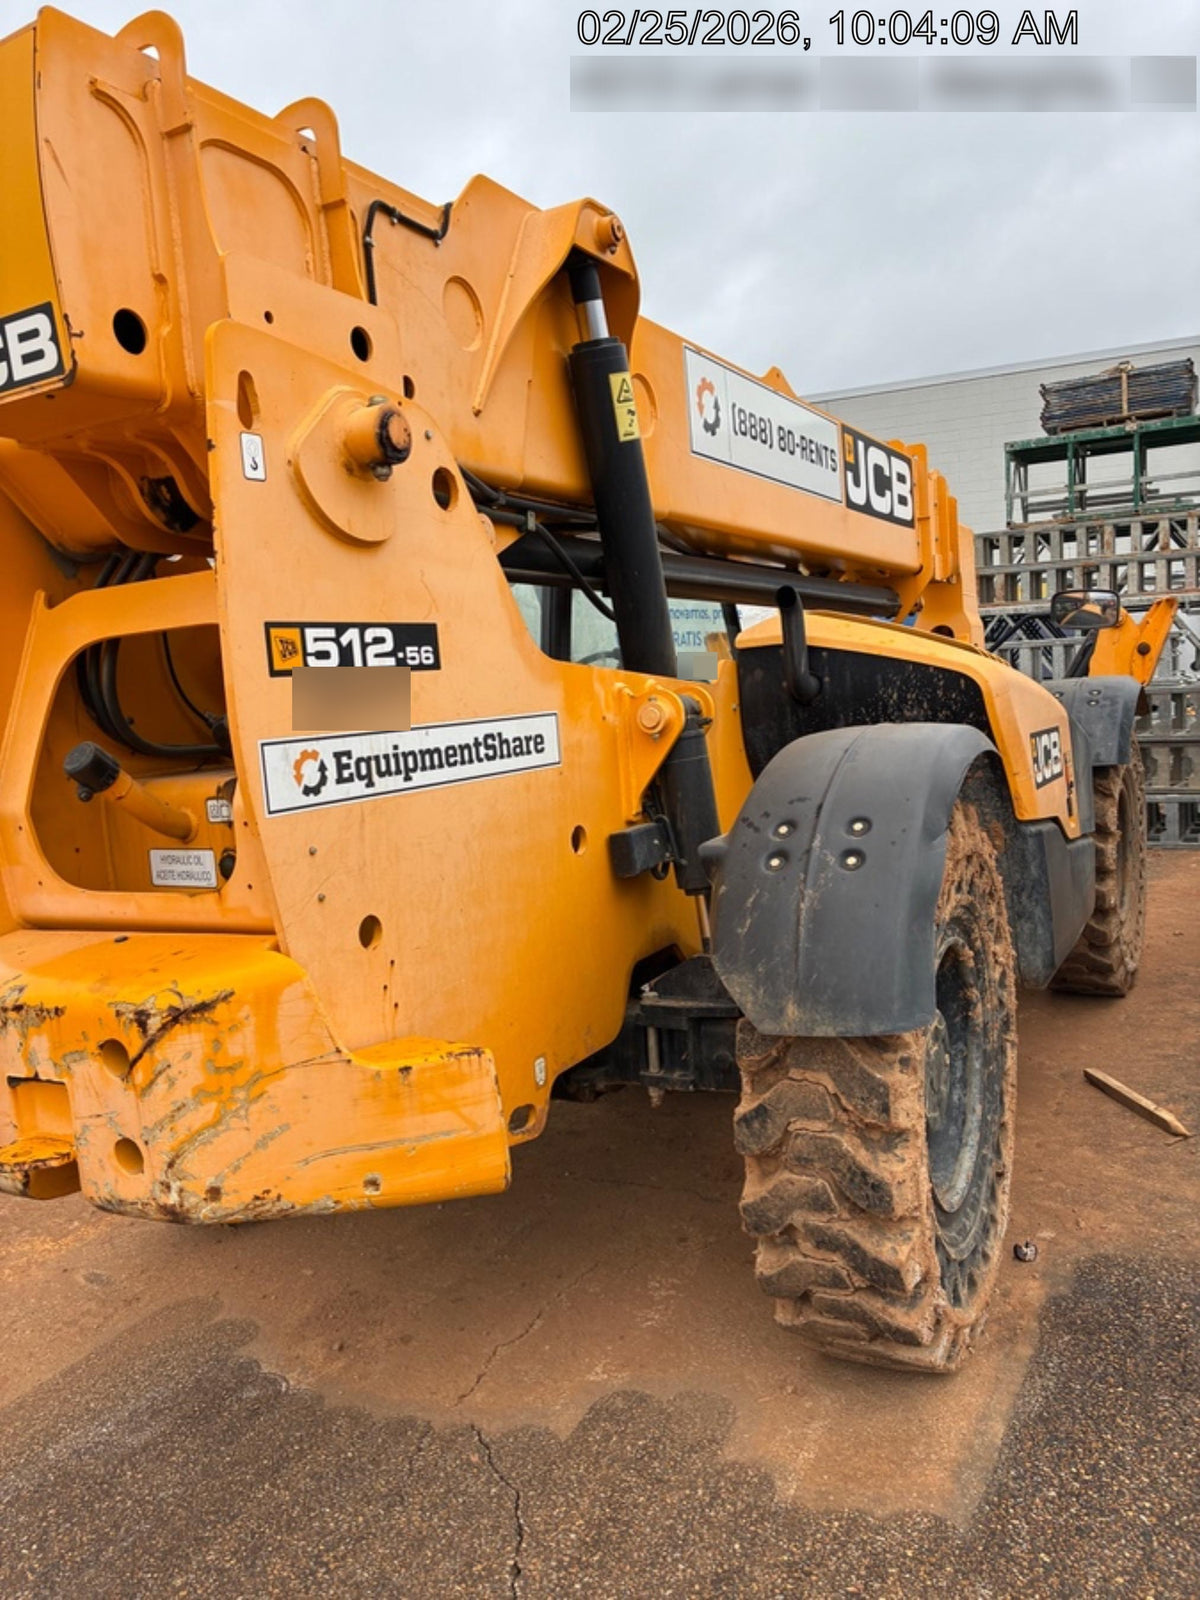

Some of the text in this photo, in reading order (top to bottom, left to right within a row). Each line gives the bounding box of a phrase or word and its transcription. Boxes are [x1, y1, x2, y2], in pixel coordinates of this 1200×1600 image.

[732, 402, 838, 473] (888) 80-RENTS
[846, 440, 913, 521] JCB
[332, 732, 545, 788] EquipmentShare
[1034, 731, 1062, 783] JCB
